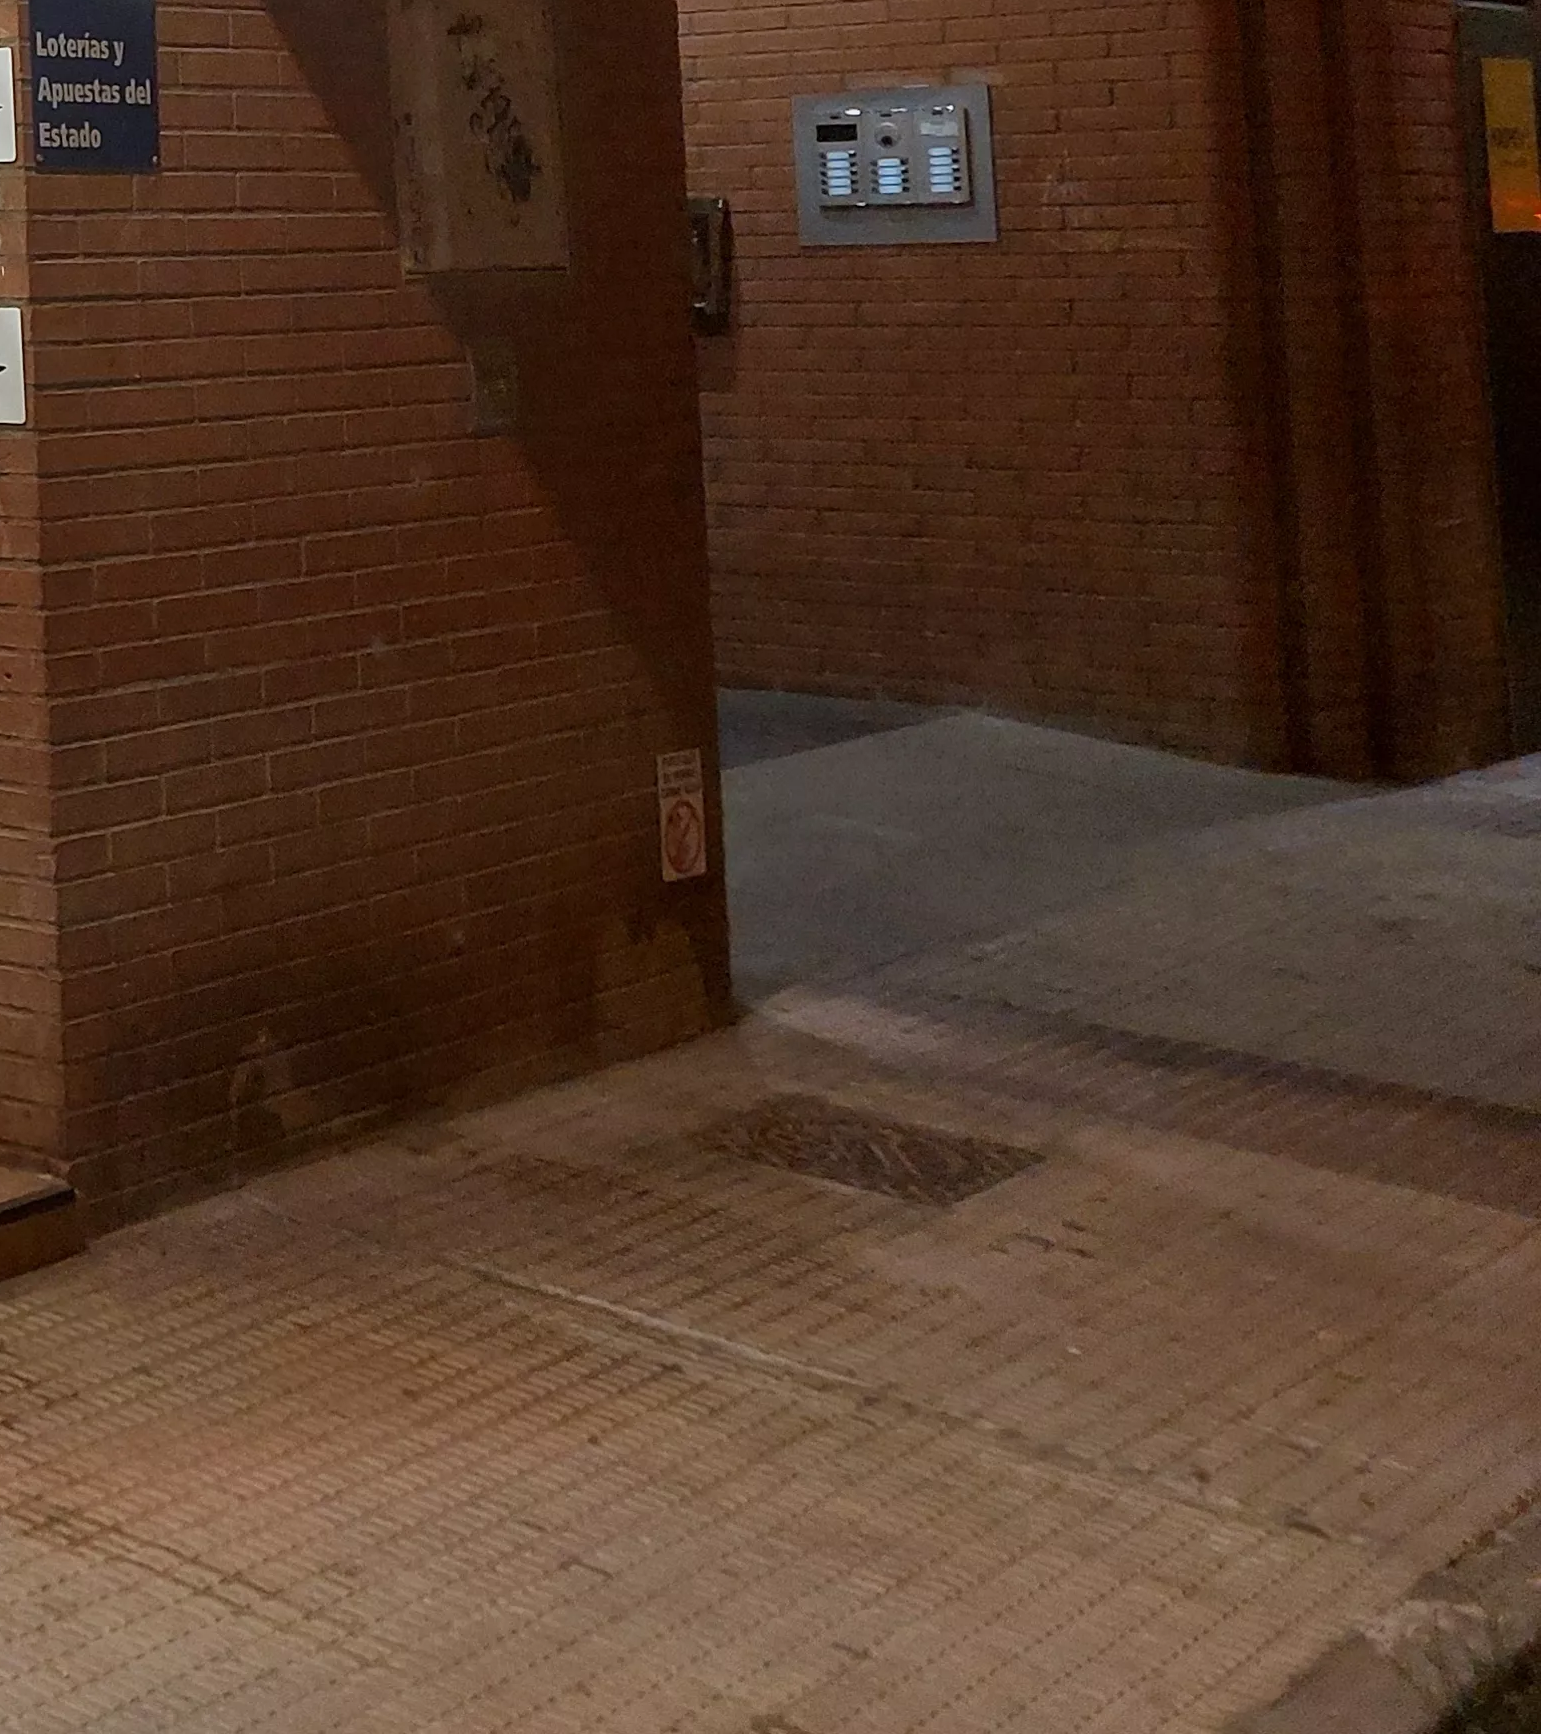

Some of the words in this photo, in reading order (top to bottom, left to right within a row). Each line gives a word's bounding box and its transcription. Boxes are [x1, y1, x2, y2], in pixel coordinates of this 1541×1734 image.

[35, 31, 110, 62] Loterías
[113, 43, 125, 66] y
[37, 78, 121, 110] Apuestas
[125, 77, 152, 105] del
[38, 122, 103, 150] Estado
